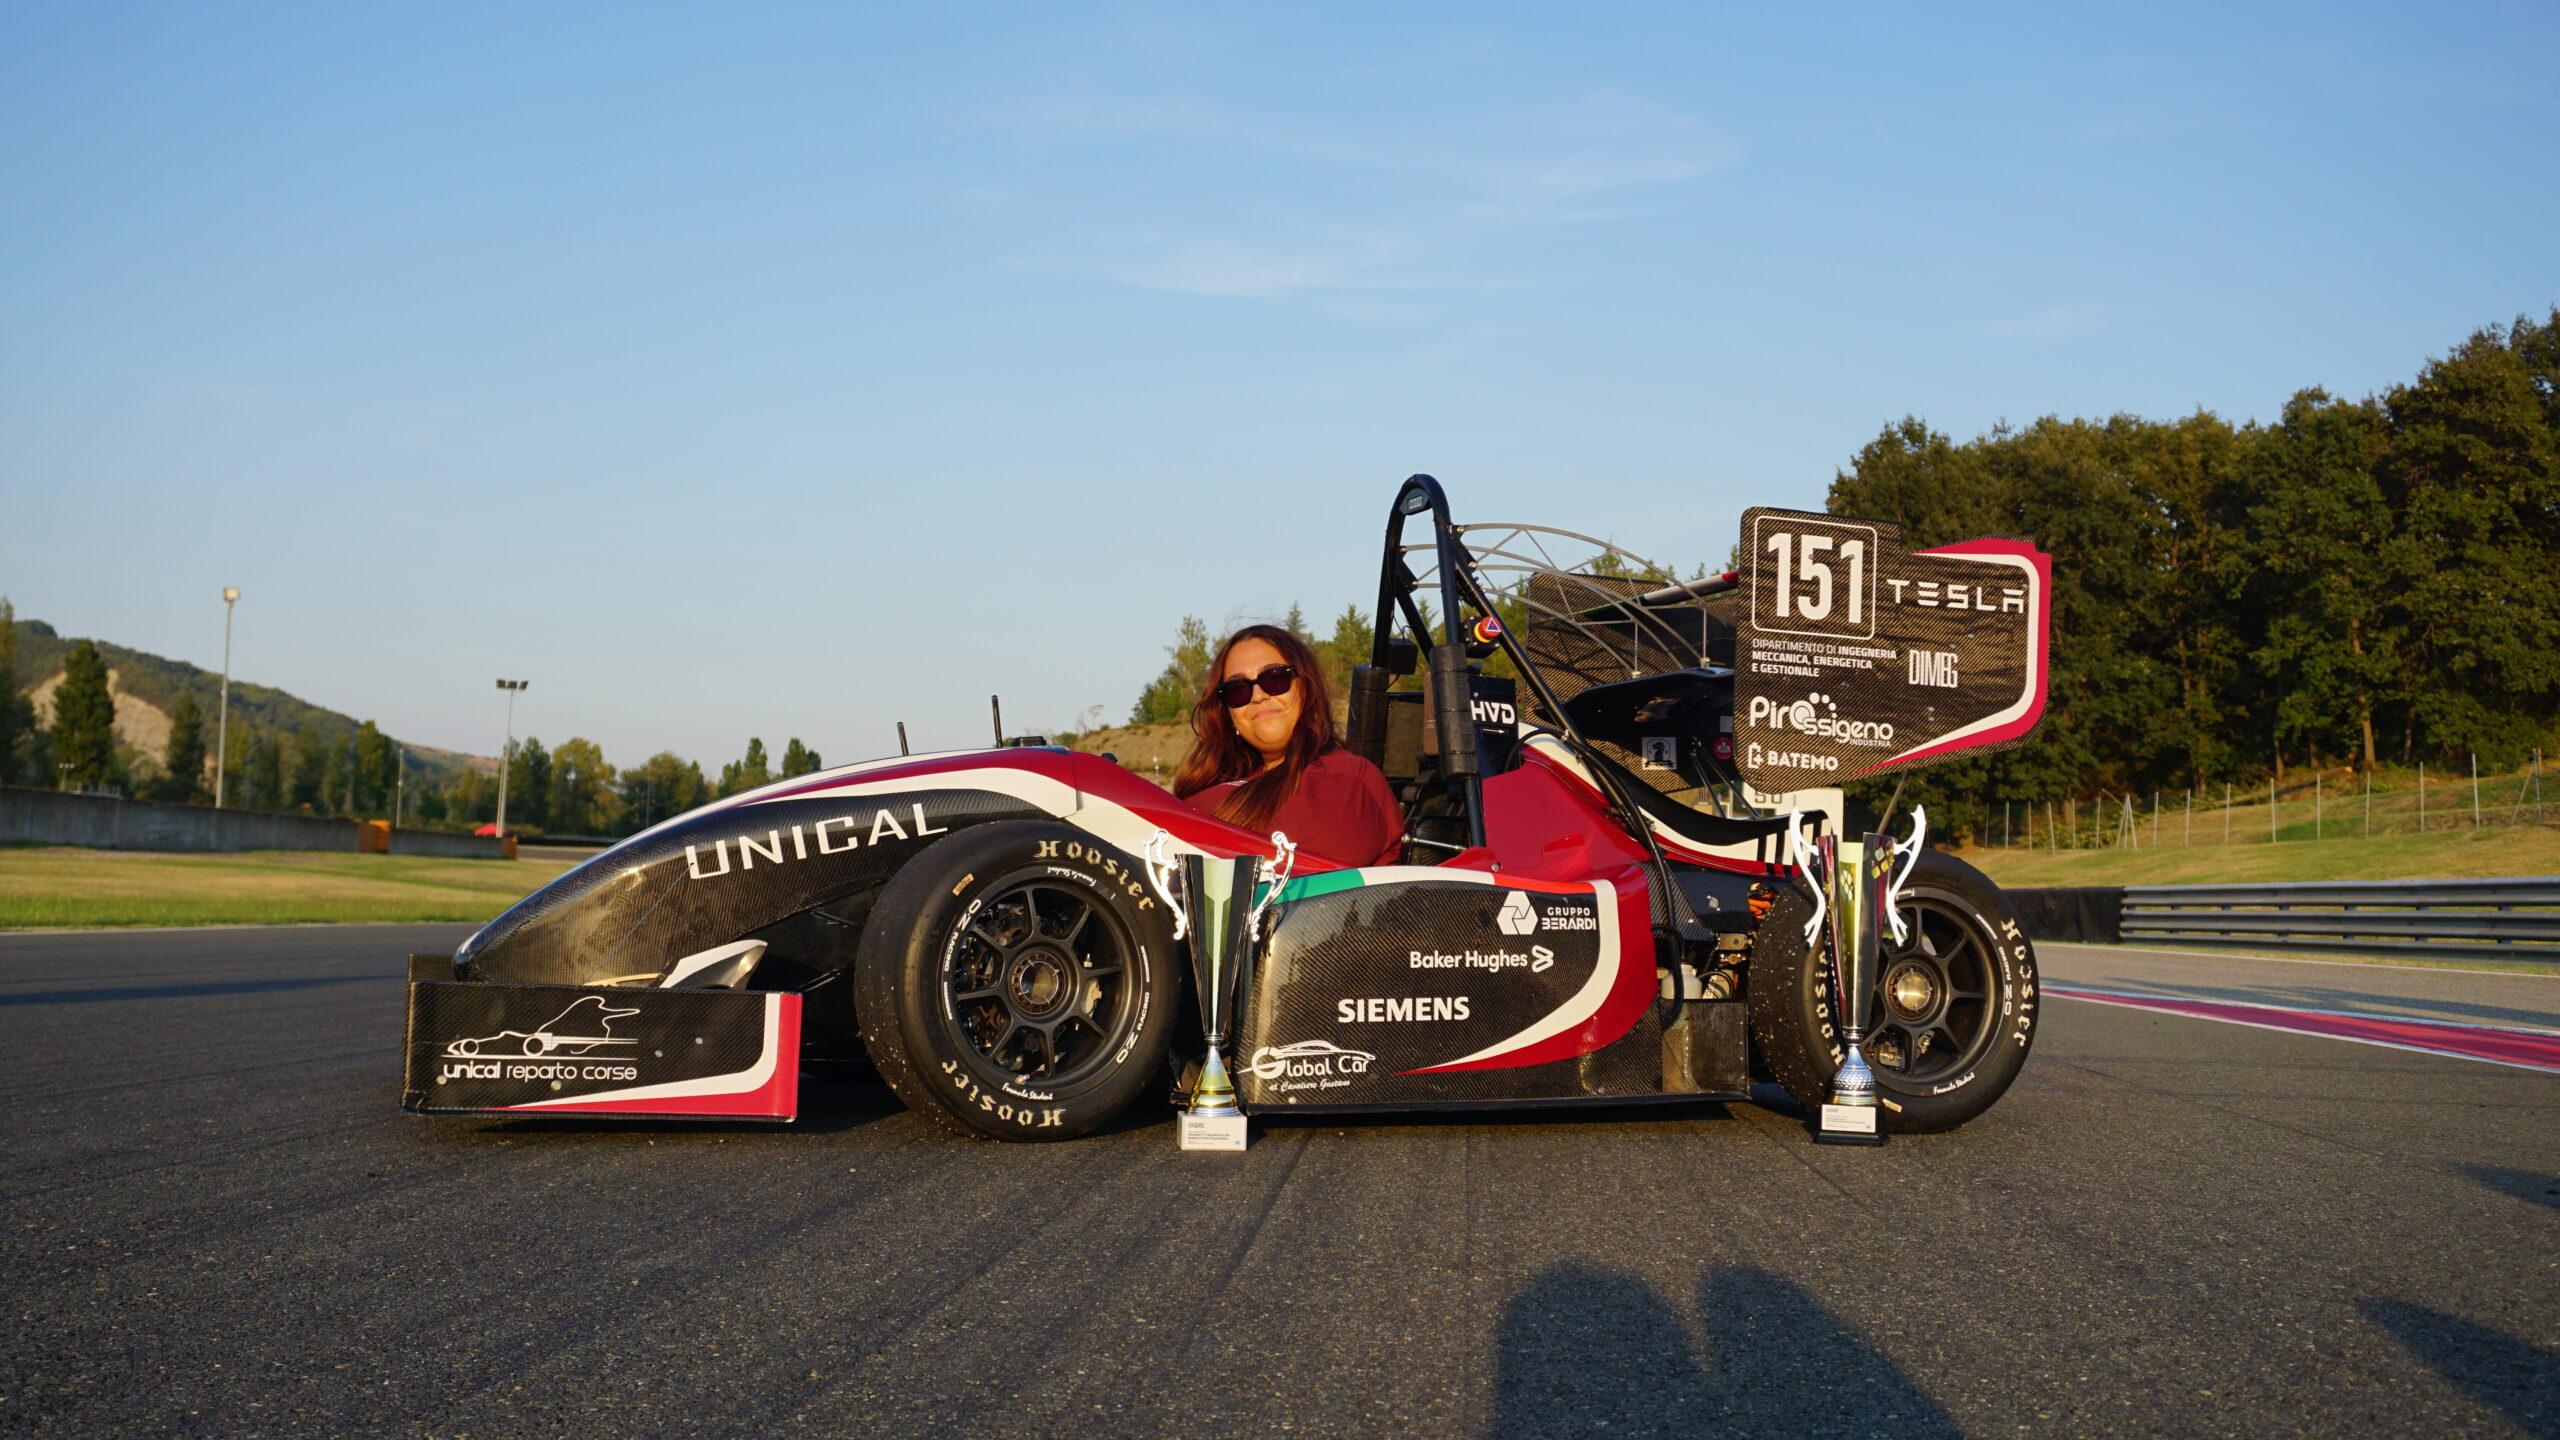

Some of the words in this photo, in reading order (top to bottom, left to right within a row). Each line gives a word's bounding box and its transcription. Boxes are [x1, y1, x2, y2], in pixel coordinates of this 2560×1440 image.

[1768, 532, 1864, 624] 151
[1886, 578, 2025, 614] TESLA
[1752, 651, 1811, 665] MECCANICA,
[1813, 656, 1873, 670] ENERGETICA
[1753, 639, 1825, 654] DIPARTIMENTO
[1826, 645, 1838, 655] DI
[1838, 645, 1897, 660] INGEGNERIA
[1752, 663, 1759, 673] E
[1760, 664, 1820, 678] GESTIONALE
[1908, 649, 1959, 689] DIMEG
[1470, 700, 1516, 725] HVD
[1850, 738, 1891, 748] INDUSTRIA
[1767, 750, 1839, 771] BATEMO
[685, 803, 948, 880] UNICAL
[1033, 840, 1155, 911] Hoosier
[1541, 917, 1597, 931] BERARDI
[1547, 907, 1591, 917] GRUPPO
[944, 932, 959, 972] RACING
[1410, 950, 1463, 969] Baker
[1465, 949, 1529, 973] Hughes
[2001, 917, 2034, 1047] Hoosier
[1137, 992, 1150, 1031] RACING
[1337, 996, 1470, 1023] SIEMENS
[1814, 950, 1846, 1066] Hoosie
[443, 1060, 501, 1079] unical
[507, 1062, 578, 1083] reparto
[583, 1066, 637, 1081] corse
[1251, 1046, 1333, 1080] Global
[1338, 1056, 1370, 1073] Car
[942, 1060, 1067, 1128] Hoosier
